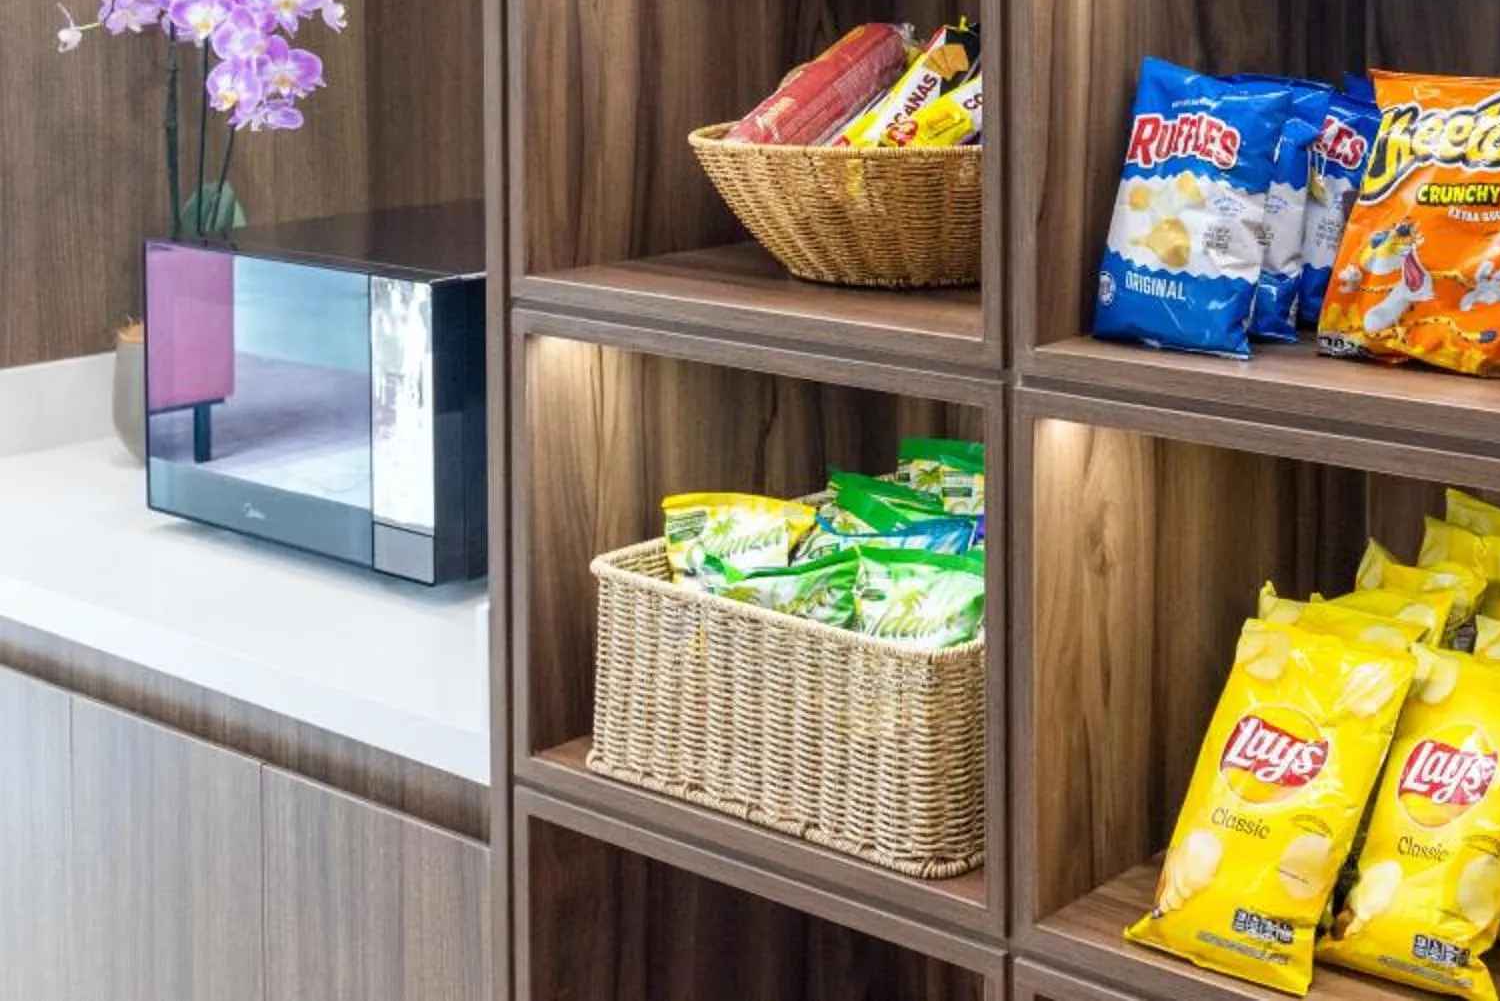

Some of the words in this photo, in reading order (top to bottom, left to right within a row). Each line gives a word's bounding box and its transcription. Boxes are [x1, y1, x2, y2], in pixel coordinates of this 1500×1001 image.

[1126, 113, 1241, 170] RUFFLES
[1125, 271, 1186, 300] ORIGINAL
[1222, 717, 1324, 784] Lay's
[1401, 741, 1497, 804] Lay's
[1211, 807, 1270, 840] Classic
